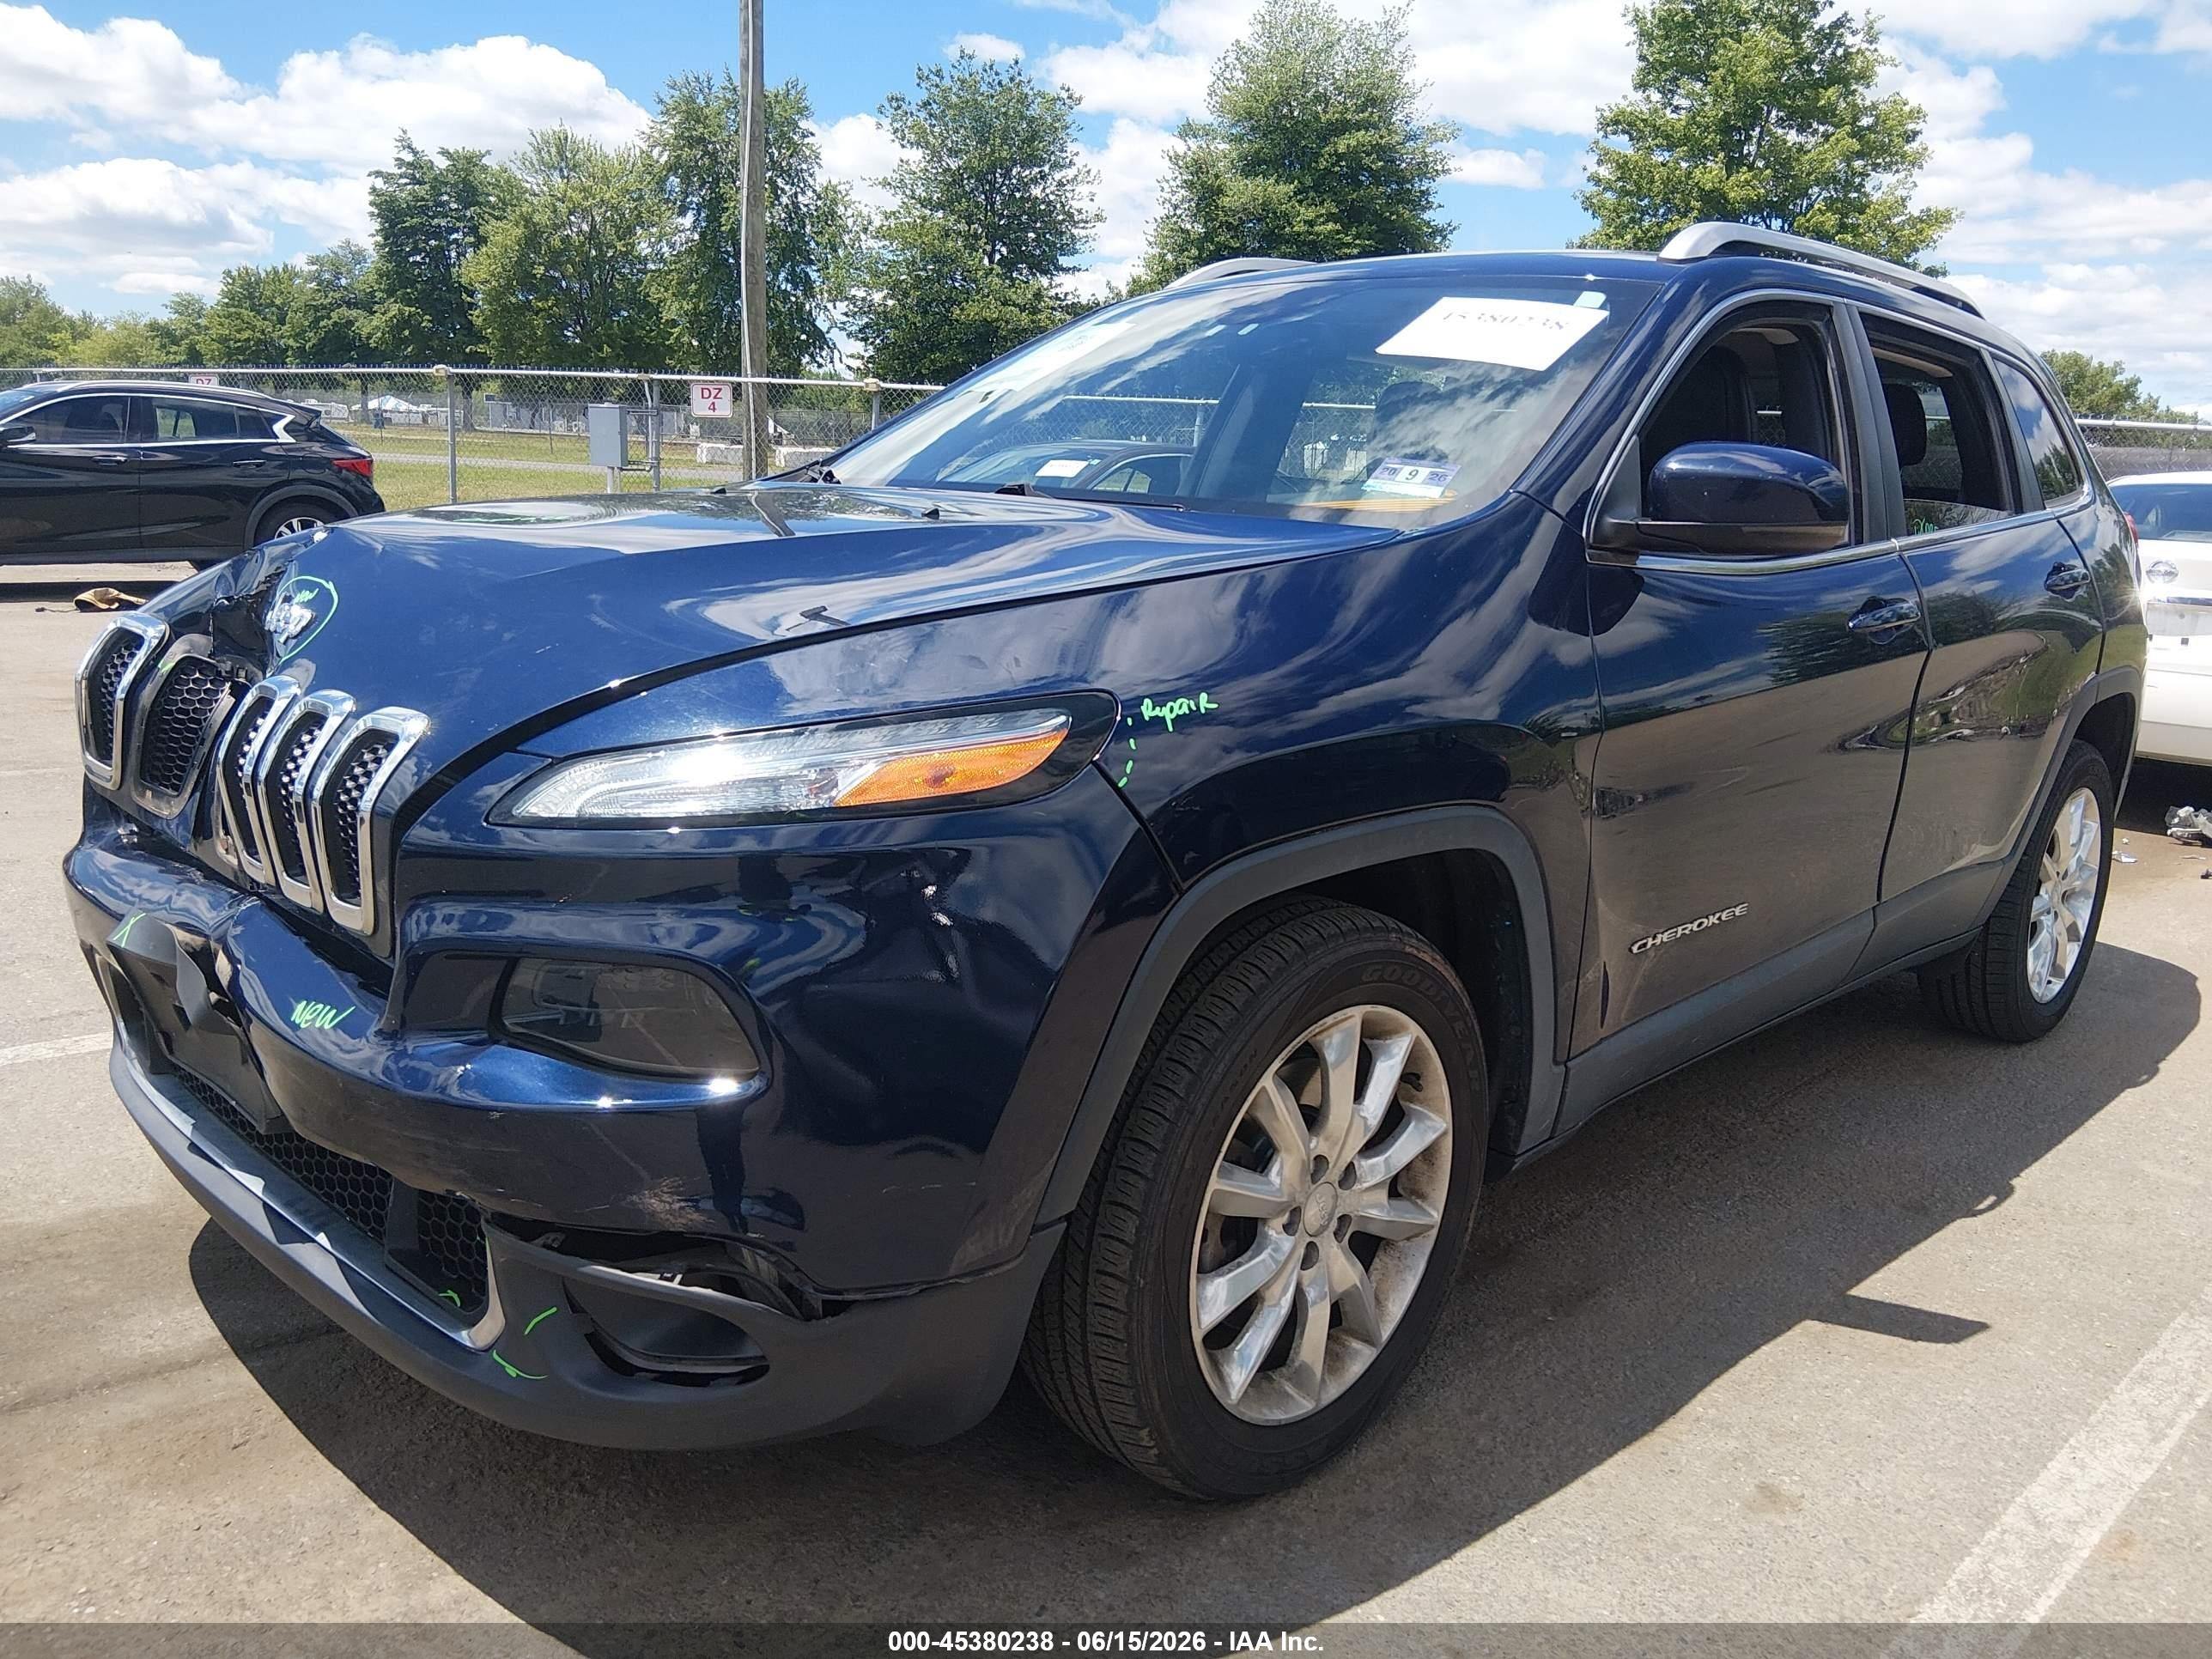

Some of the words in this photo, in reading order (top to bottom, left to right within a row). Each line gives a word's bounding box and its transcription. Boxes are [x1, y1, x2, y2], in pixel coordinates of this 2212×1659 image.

[701, 387, 723, 399] DZ
[708, 401, 717, 413] 4
[1379, 467, 1397, 477] 20
[1405, 469, 1419, 481] 9
[1428, 473, 1449, 483] 26
[1630, 902, 1749, 954] CHEROKEE
